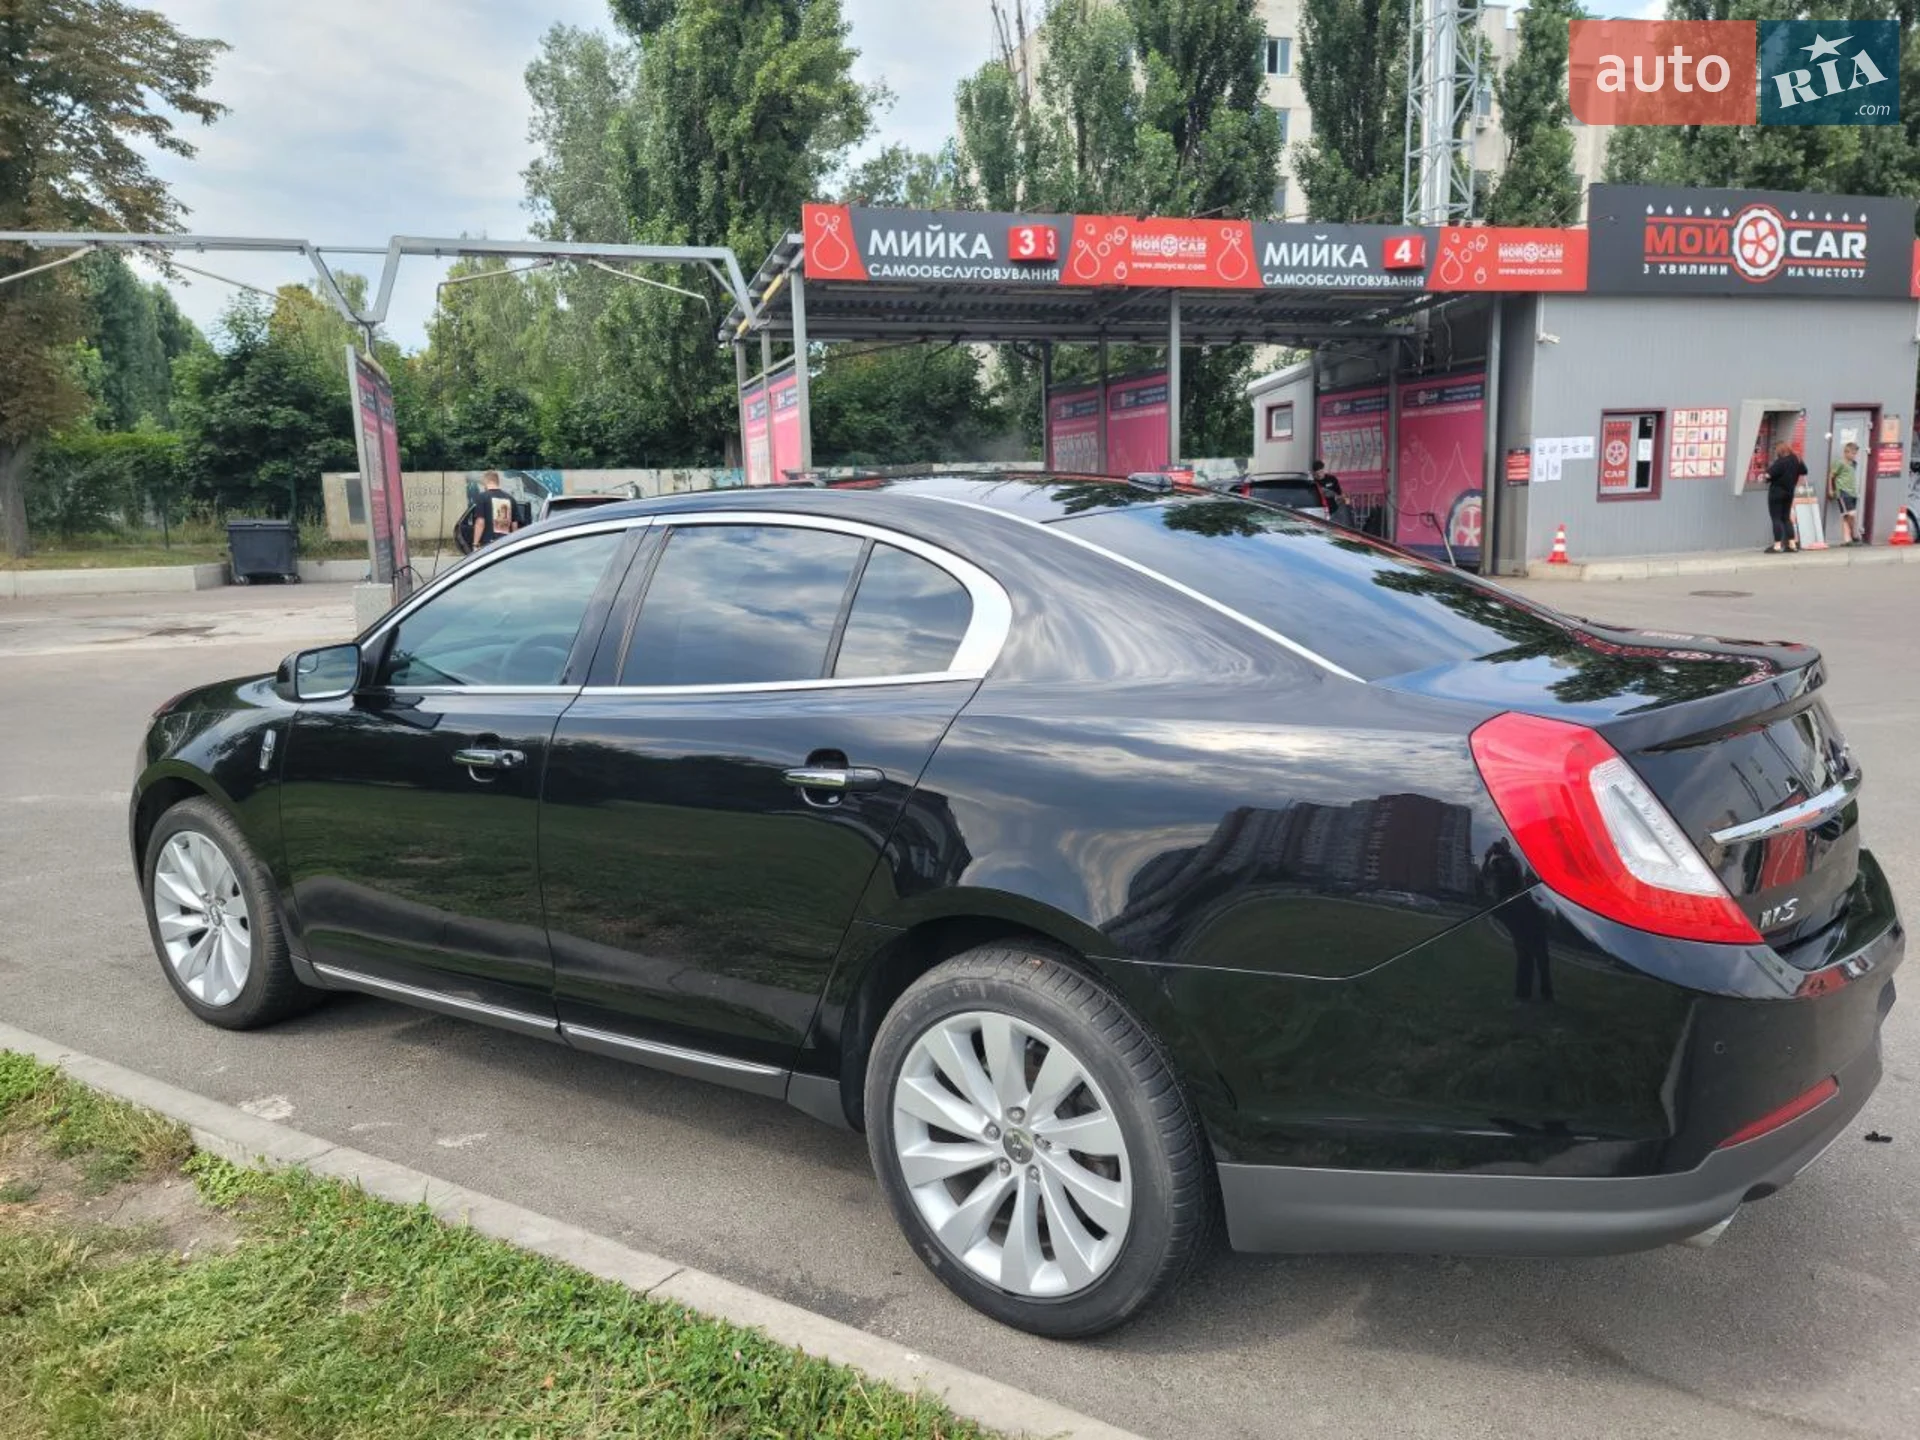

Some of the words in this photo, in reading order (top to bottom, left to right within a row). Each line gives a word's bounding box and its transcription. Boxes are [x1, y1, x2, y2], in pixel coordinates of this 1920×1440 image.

[868, 224, 993, 260] МИЙКА
[1019, 229, 1035, 256] 3
[1179, 241, 1207, 252] CAR
[1644, 222, 1729, 255] МОЙ
[1790, 229, 1866, 259] CAR
[1263, 235, 1368, 268] МИЙКА
[1393, 239, 1412, 263] 4
[868, 263, 1060, 281] САМООБСЛУГОВУВАННЯ
[1262, 273, 1424, 287] САМООБСЛУГОВУВАННЯ
[1659, 264, 1728, 275] ХВИЛИНИ
[1788, 268, 1804, 277] НА
[1807, 268, 1865, 278] ЧИСТОТУ
